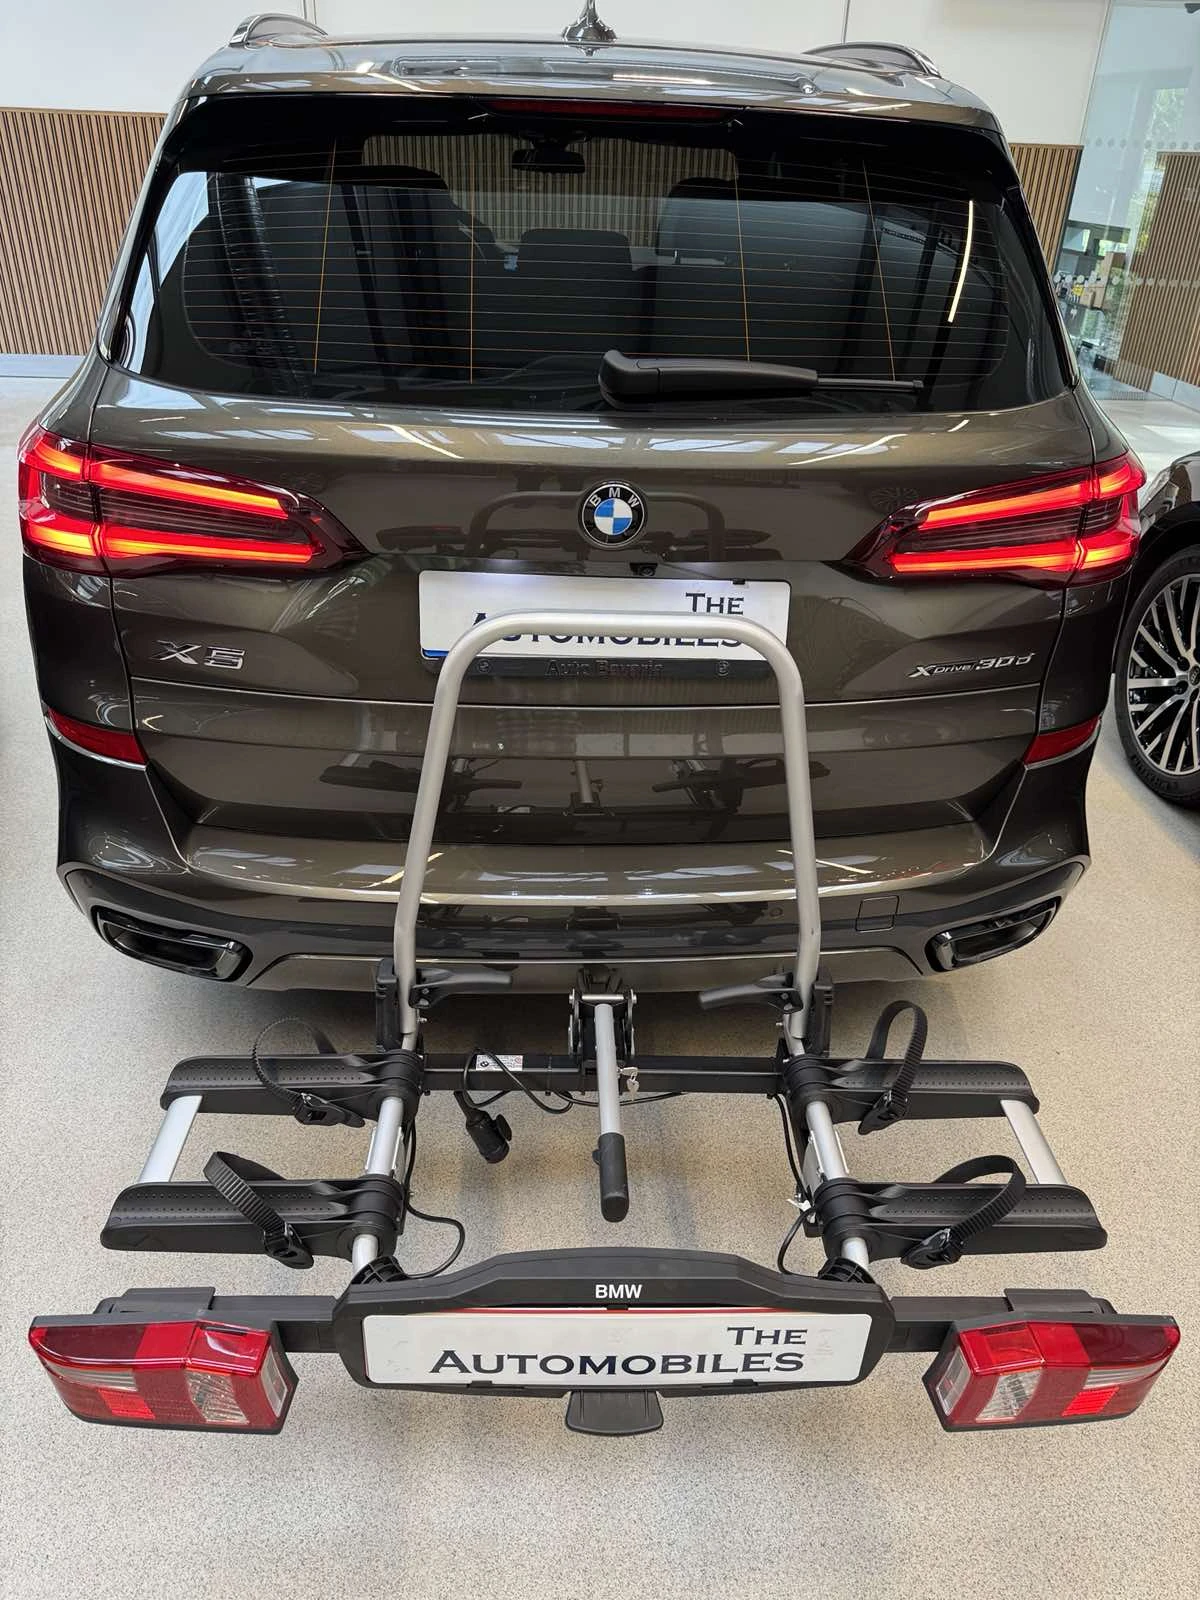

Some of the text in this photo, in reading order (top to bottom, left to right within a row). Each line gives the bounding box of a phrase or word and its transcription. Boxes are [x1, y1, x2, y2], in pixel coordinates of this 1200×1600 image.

[589, 487, 640, 508] BMW
[686, 592, 745, 615] THE
[148, 639, 246, 670] X5
[595, 1284, 643, 1299] BMW
[727, 1326, 808, 1346] THE
[429, 1350, 804, 1375] AUTOMOBILES
